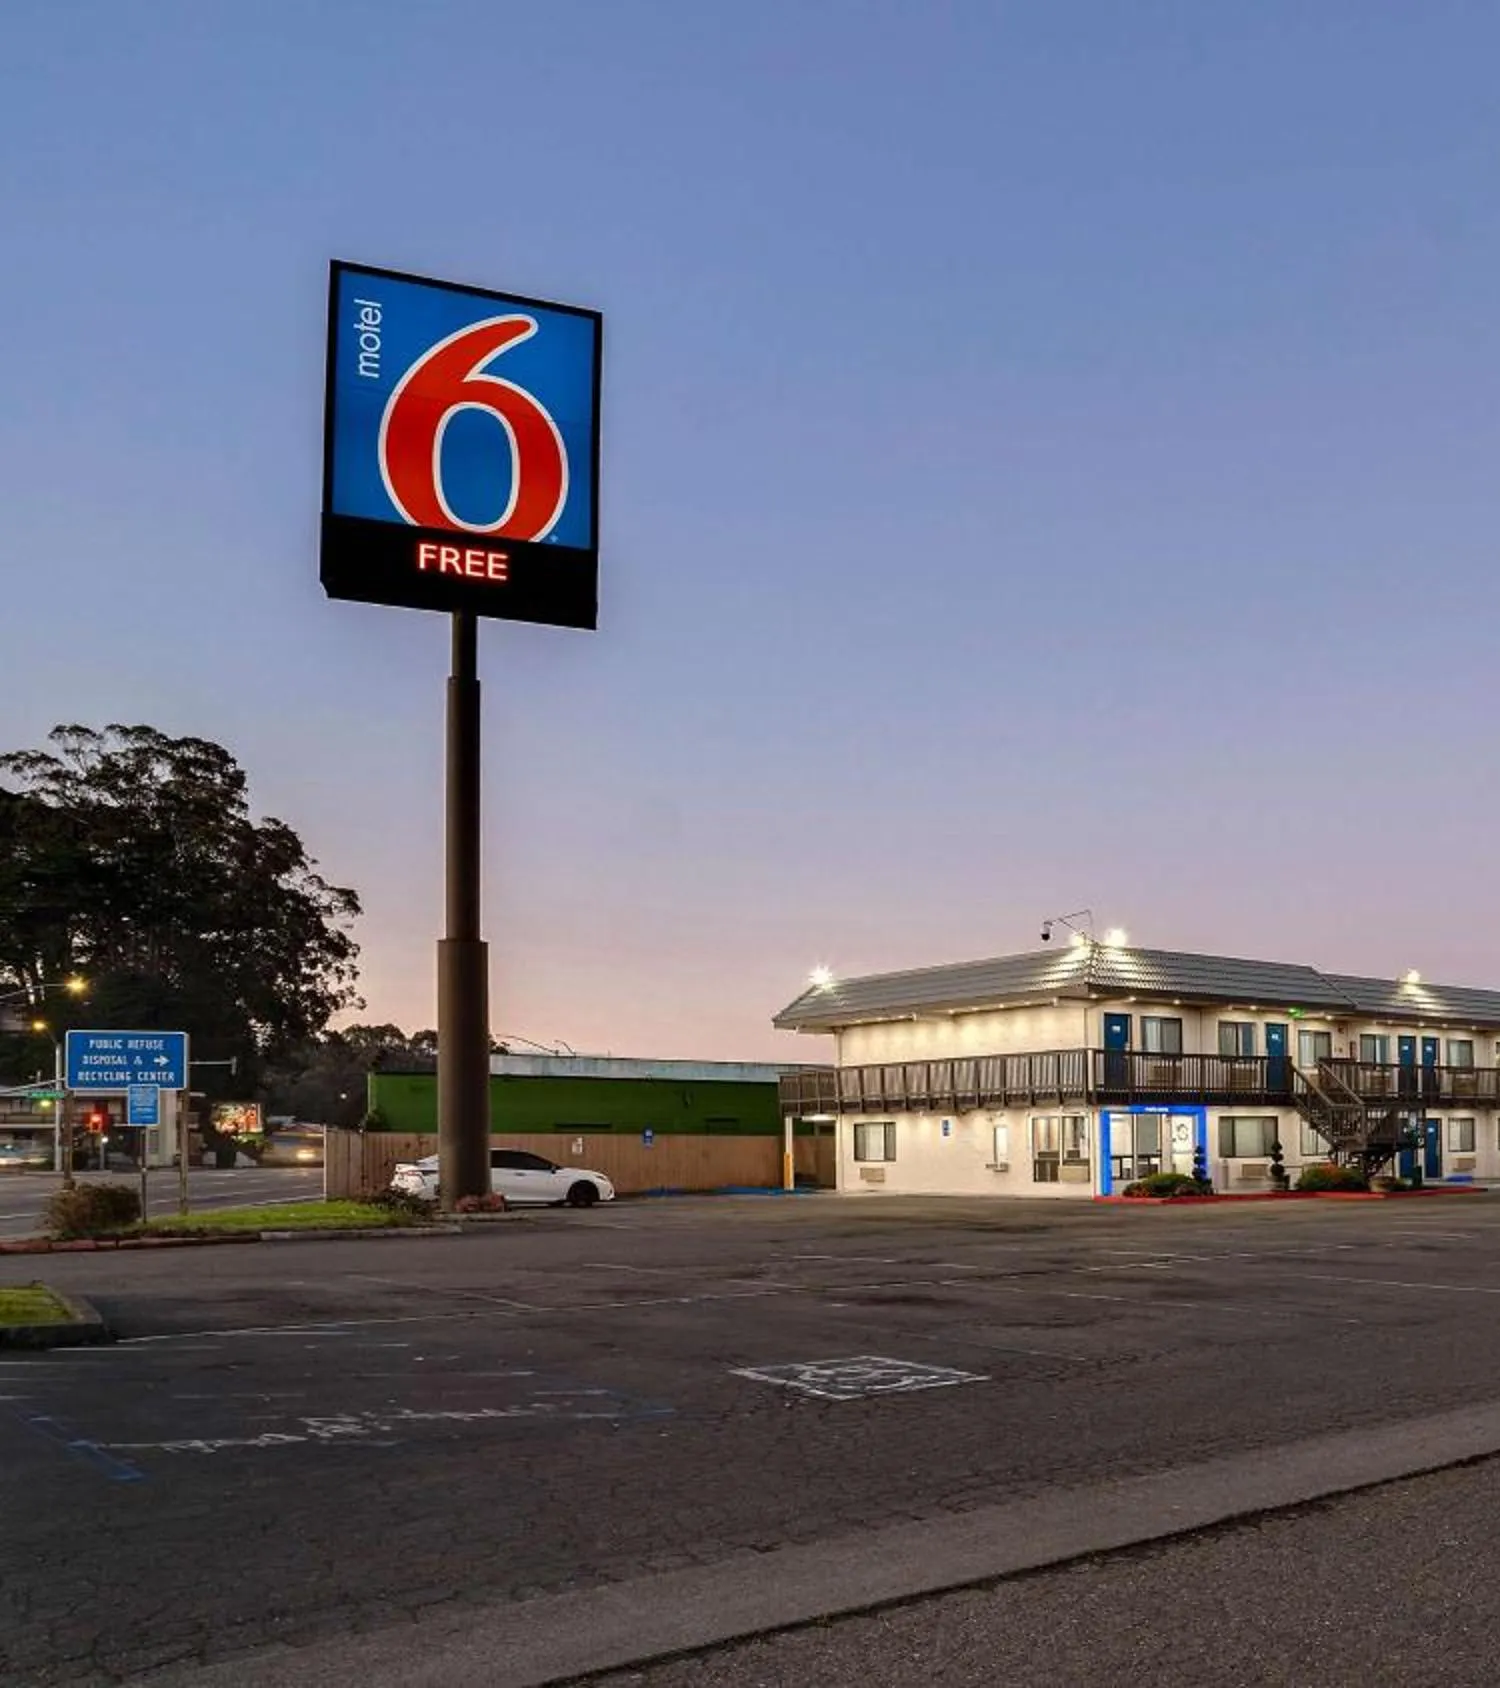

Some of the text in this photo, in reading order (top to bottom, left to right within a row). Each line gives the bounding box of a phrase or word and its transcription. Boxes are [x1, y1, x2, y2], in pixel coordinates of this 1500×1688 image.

[354, 299, 382, 378] motel
[378, 314, 569, 542] 6
[418, 543, 508, 581] FREE
[90, 1039, 164, 1050] PUBLIC REFUSE
[82, 1055, 127, 1065] DISPOSAL
[78, 1071, 175, 1082] RECYCLING CENTER
